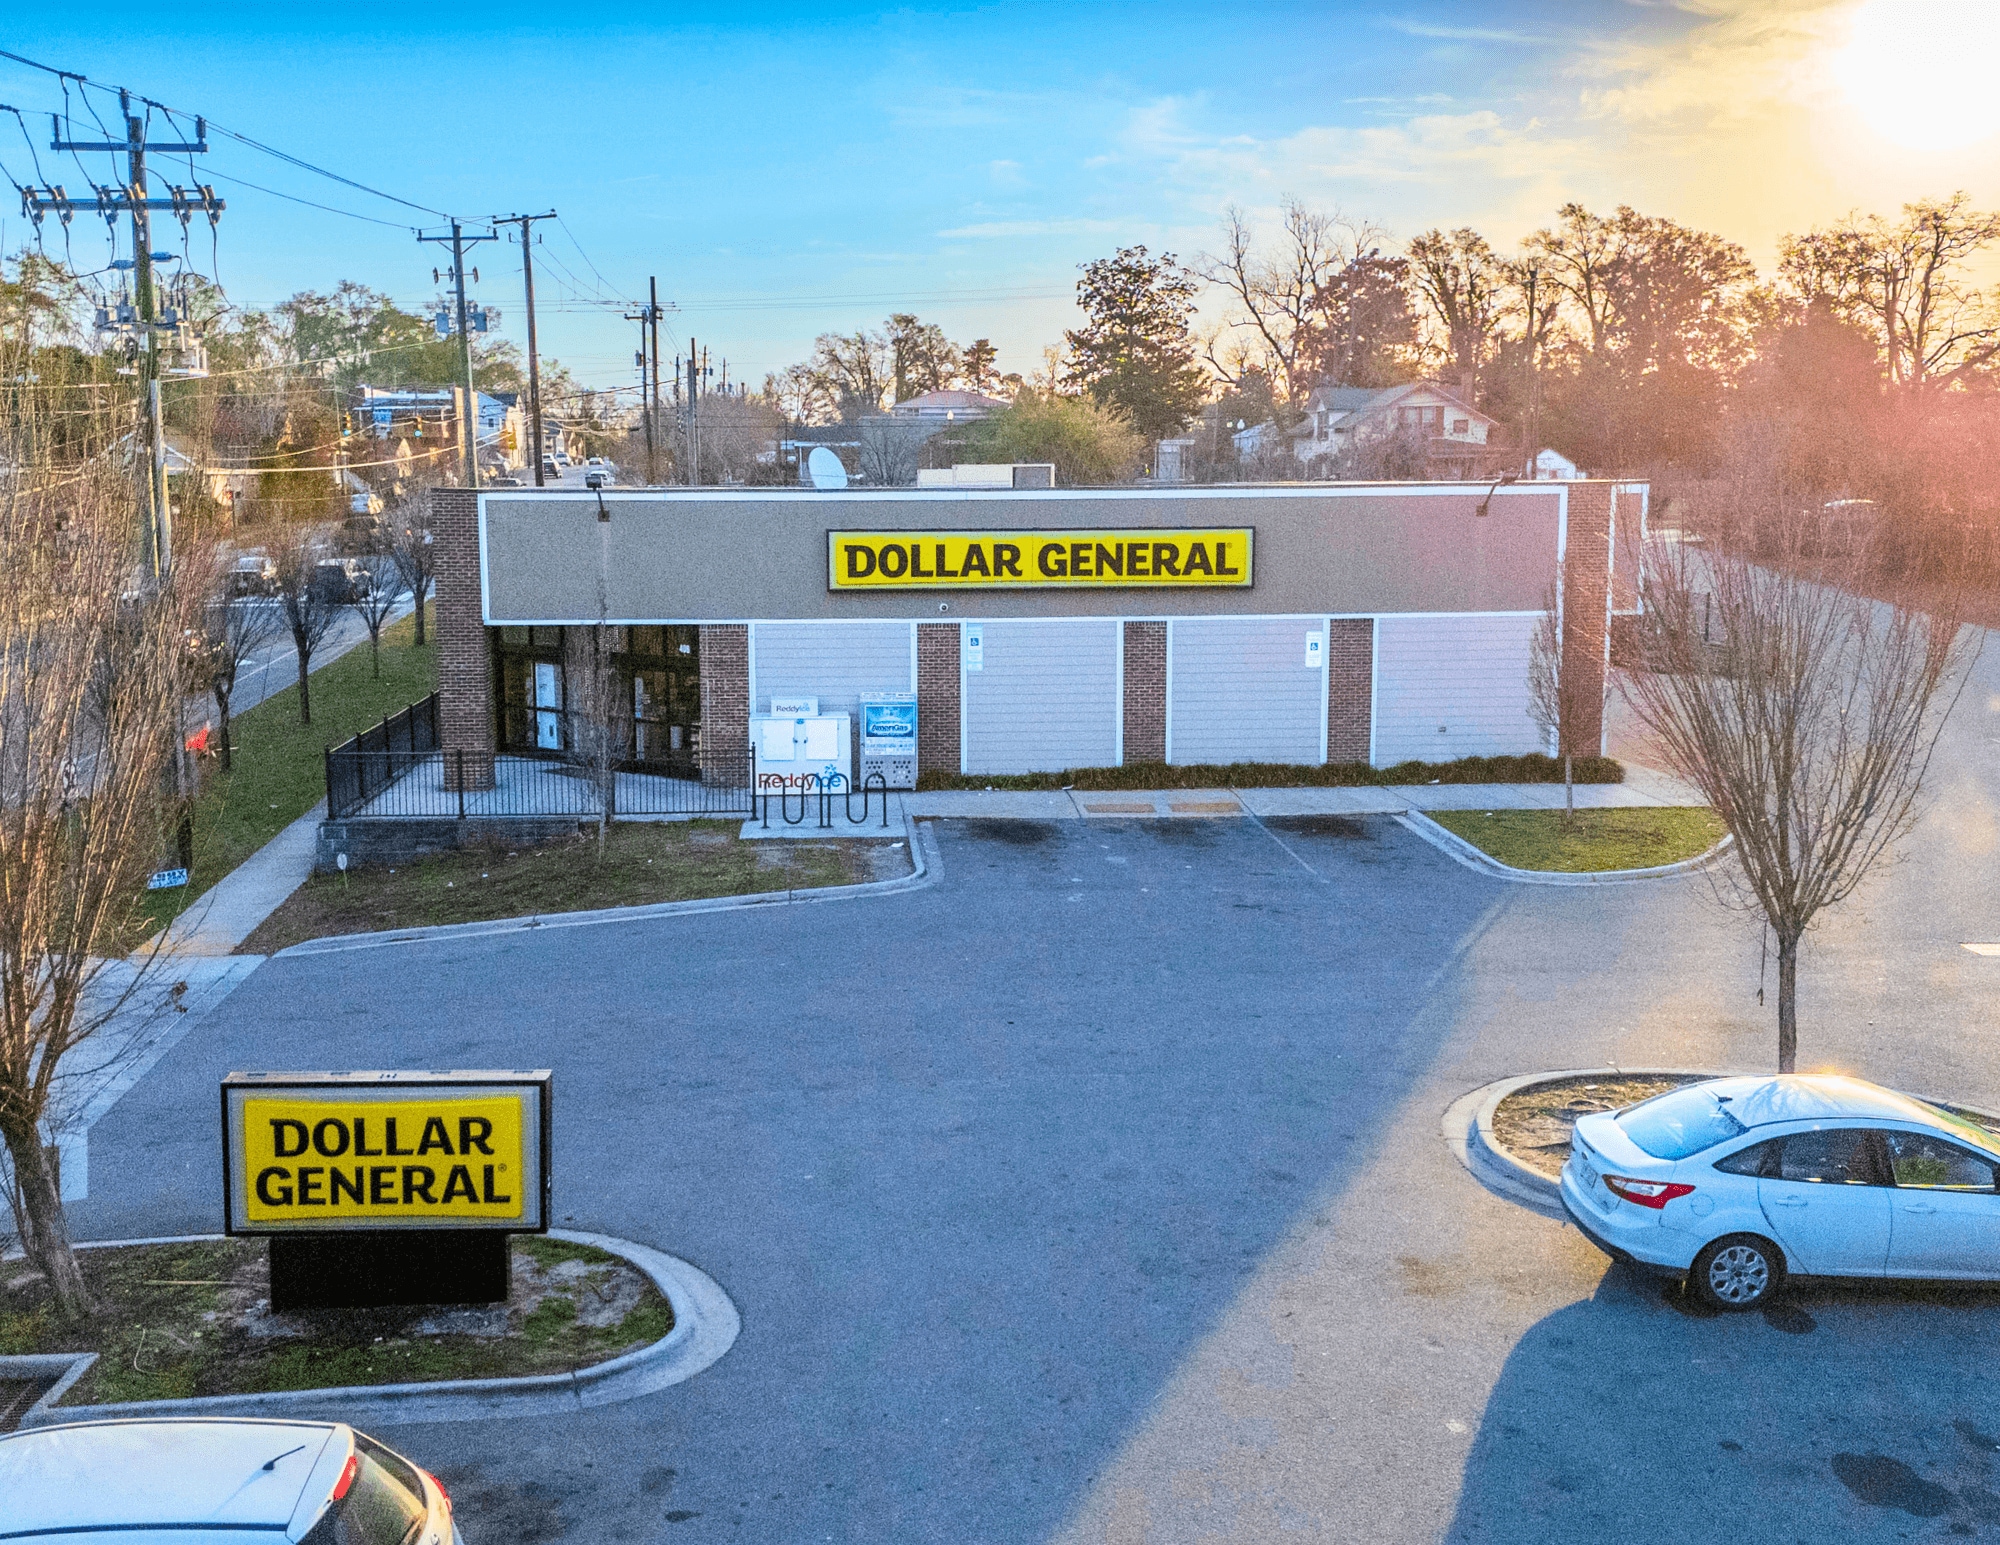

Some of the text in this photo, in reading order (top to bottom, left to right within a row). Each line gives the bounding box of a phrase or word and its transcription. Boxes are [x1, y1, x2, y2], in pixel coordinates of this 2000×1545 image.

[844, 541, 1238, 578] DOLLAR GENERAL
[269, 1116, 495, 1158] DOLLAR
[255, 1164, 512, 1207] GENERAL
